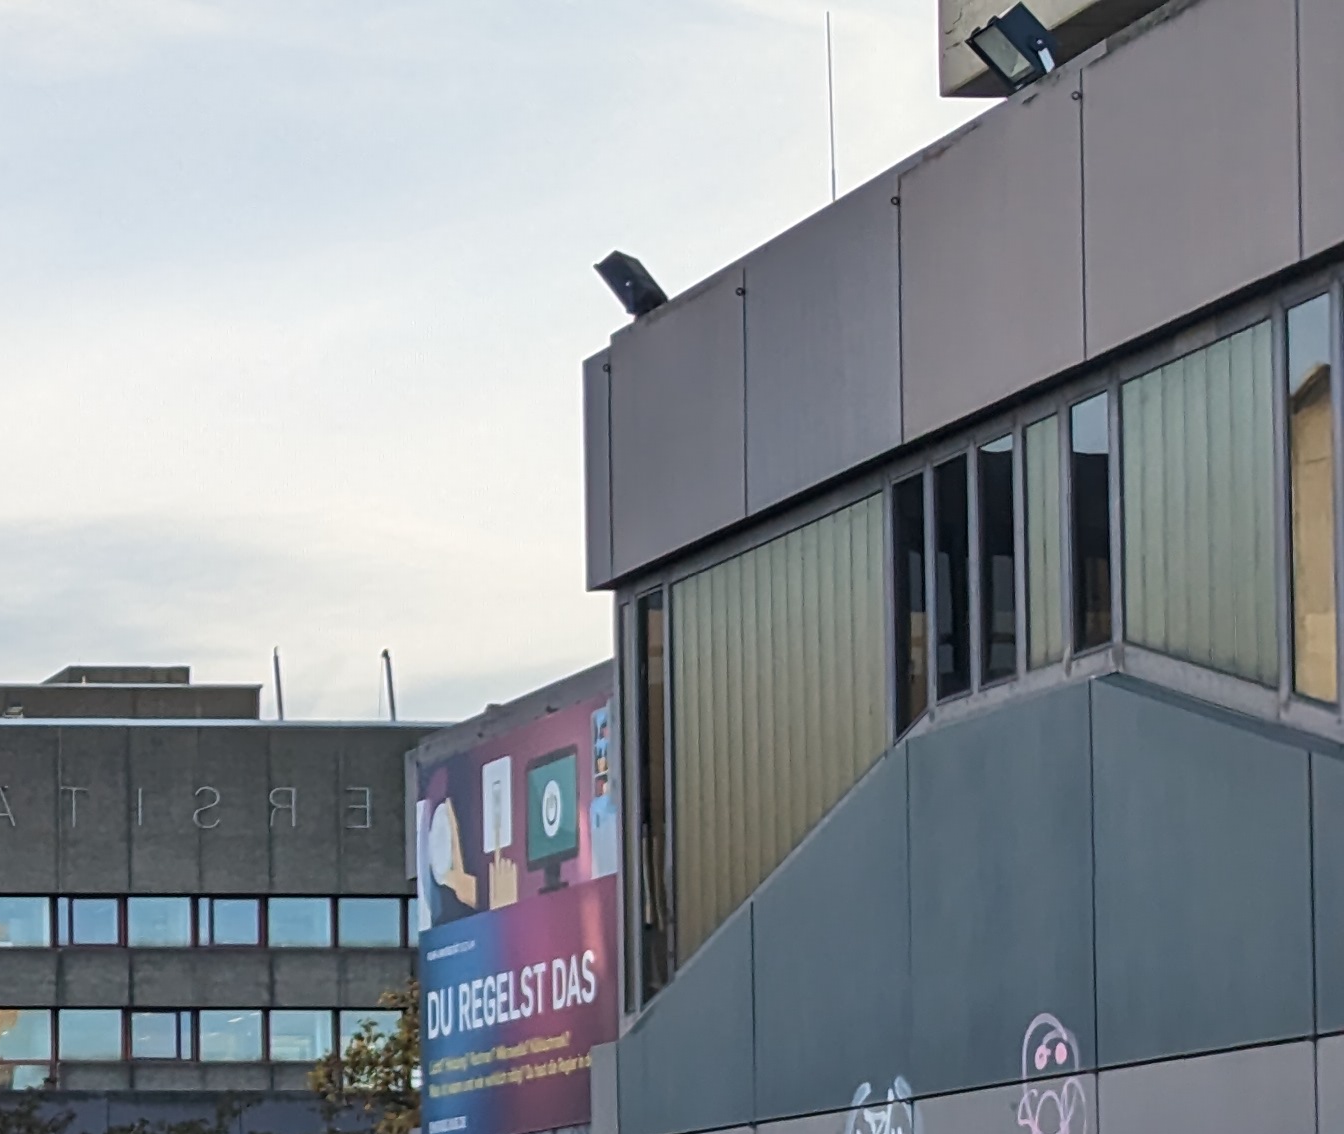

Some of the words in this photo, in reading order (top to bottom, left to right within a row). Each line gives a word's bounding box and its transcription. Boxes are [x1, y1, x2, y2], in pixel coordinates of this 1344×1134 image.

[427, 986, 453, 1040] DU
[458, 962, 547, 1033] REGELST
[552, 949, 596, 1010] DAS
